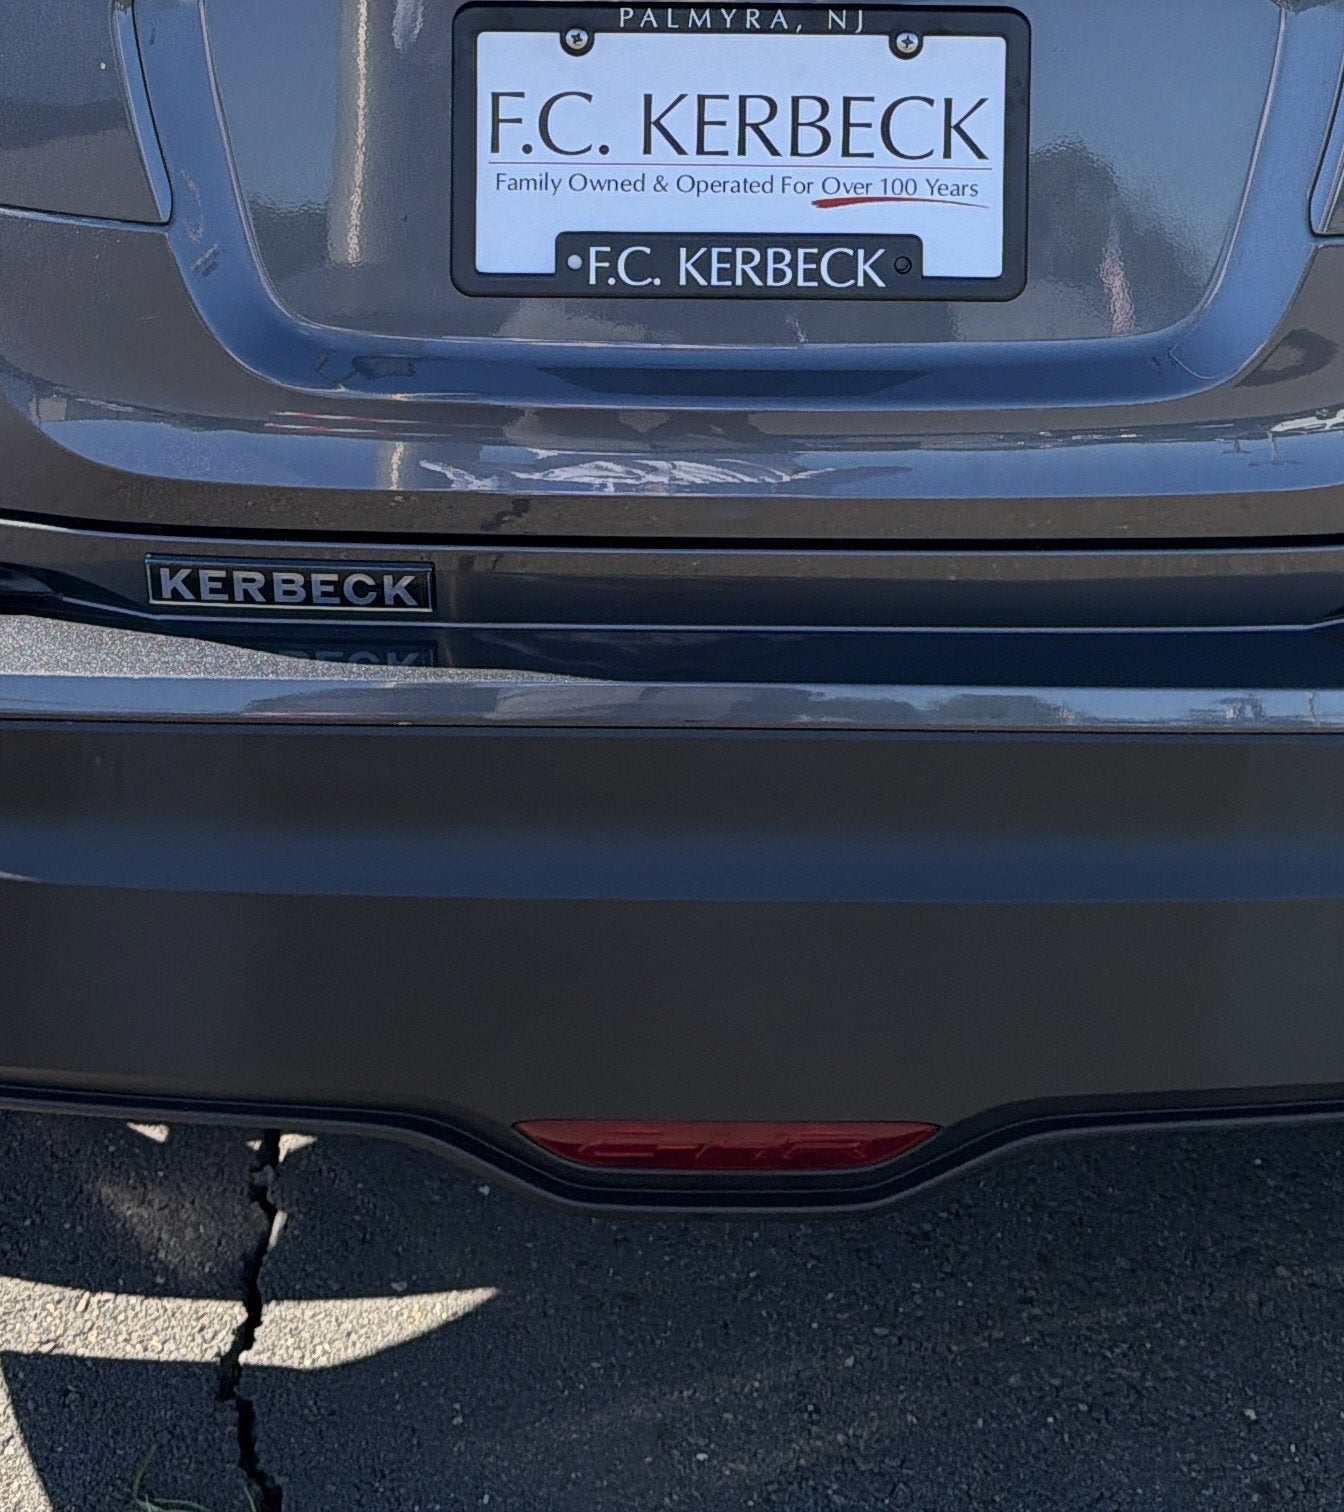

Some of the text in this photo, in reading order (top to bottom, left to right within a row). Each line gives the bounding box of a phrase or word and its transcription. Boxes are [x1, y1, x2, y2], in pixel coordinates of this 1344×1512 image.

[619, 7, 865, 33] PALMYRA, NJ
[490, 91, 989, 160] F.C. KERBECK
[495, 172, 978, 198] Family Owned & Operated For Over 100 Years
[588, 246, 887, 287] F.C. KERBECK
[159, 567, 419, 607] KERBECK
